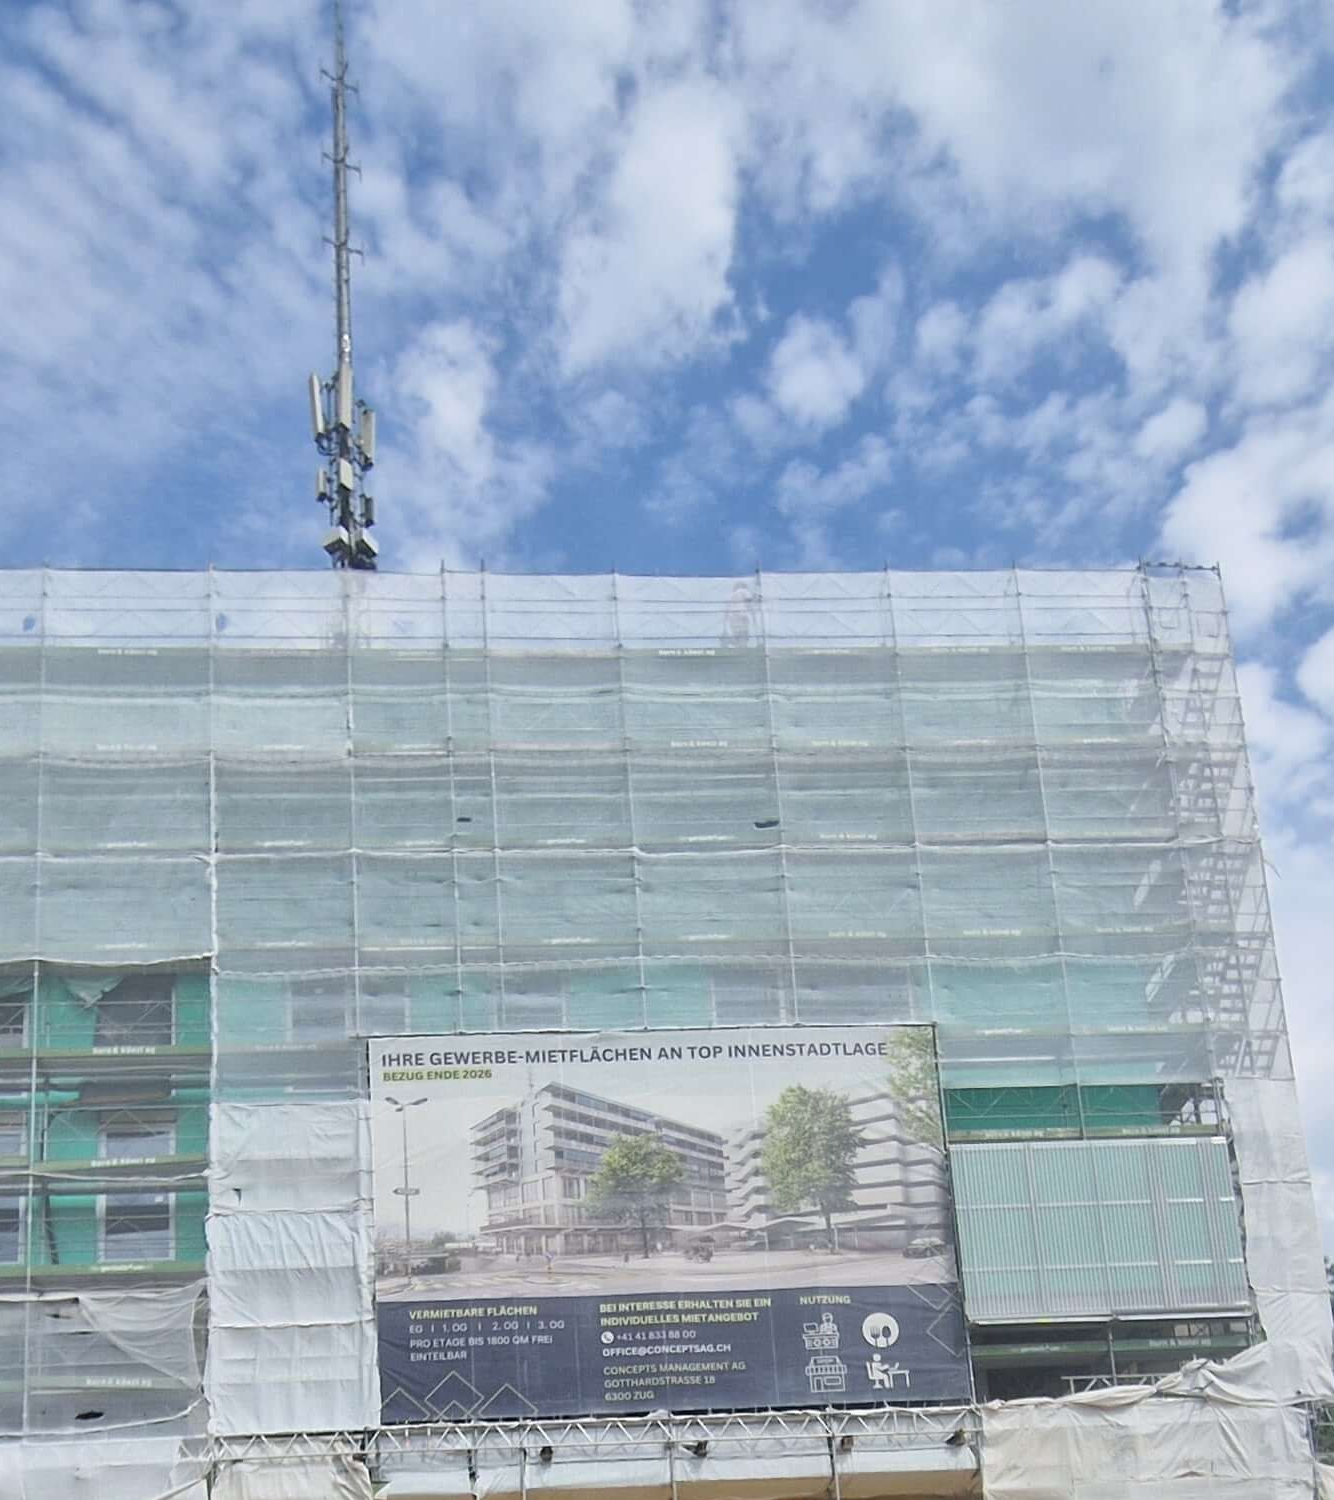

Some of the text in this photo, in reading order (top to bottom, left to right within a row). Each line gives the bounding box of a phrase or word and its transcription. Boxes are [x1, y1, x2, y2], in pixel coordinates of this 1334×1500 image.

[381, 1042, 888, 1067] IHRE GEWERBE-MIETFLÄCHEN AN TOP INNENSTADTLAGE
[383, 1069, 492, 1082] BEZUG ENDE 2026
[599, 1297, 772, 1313] BEI INTERESSE ERHALTEN SIE EIN
[800, 1295, 852, 1305] NUTZUNG
[409, 1305, 538, 1320] VERMIETBARE FLÄCHEN
[600, 1314, 680, 1327] INDIVIDUELLES
[409, 1324, 423, 1334] EG
[410, 1339, 431, 1348] PRO
[433, 1337, 466, 1347] ETAGE
[469, 1337, 484, 1346] BIS
[531, 1334, 553, 1344] FREI
[410, 1351, 468, 1361] EINTEILBAR
[602, 1344, 732, 1358] OFFICE@CONCEPTSAG.CH
[603, 1361, 747, 1375] CONCEPTS MANAGEMENT AG
[604, 1375, 716, 1389] GOTTHARDSTRASSE 18
[633, 1390, 655, 1400] ZUG
